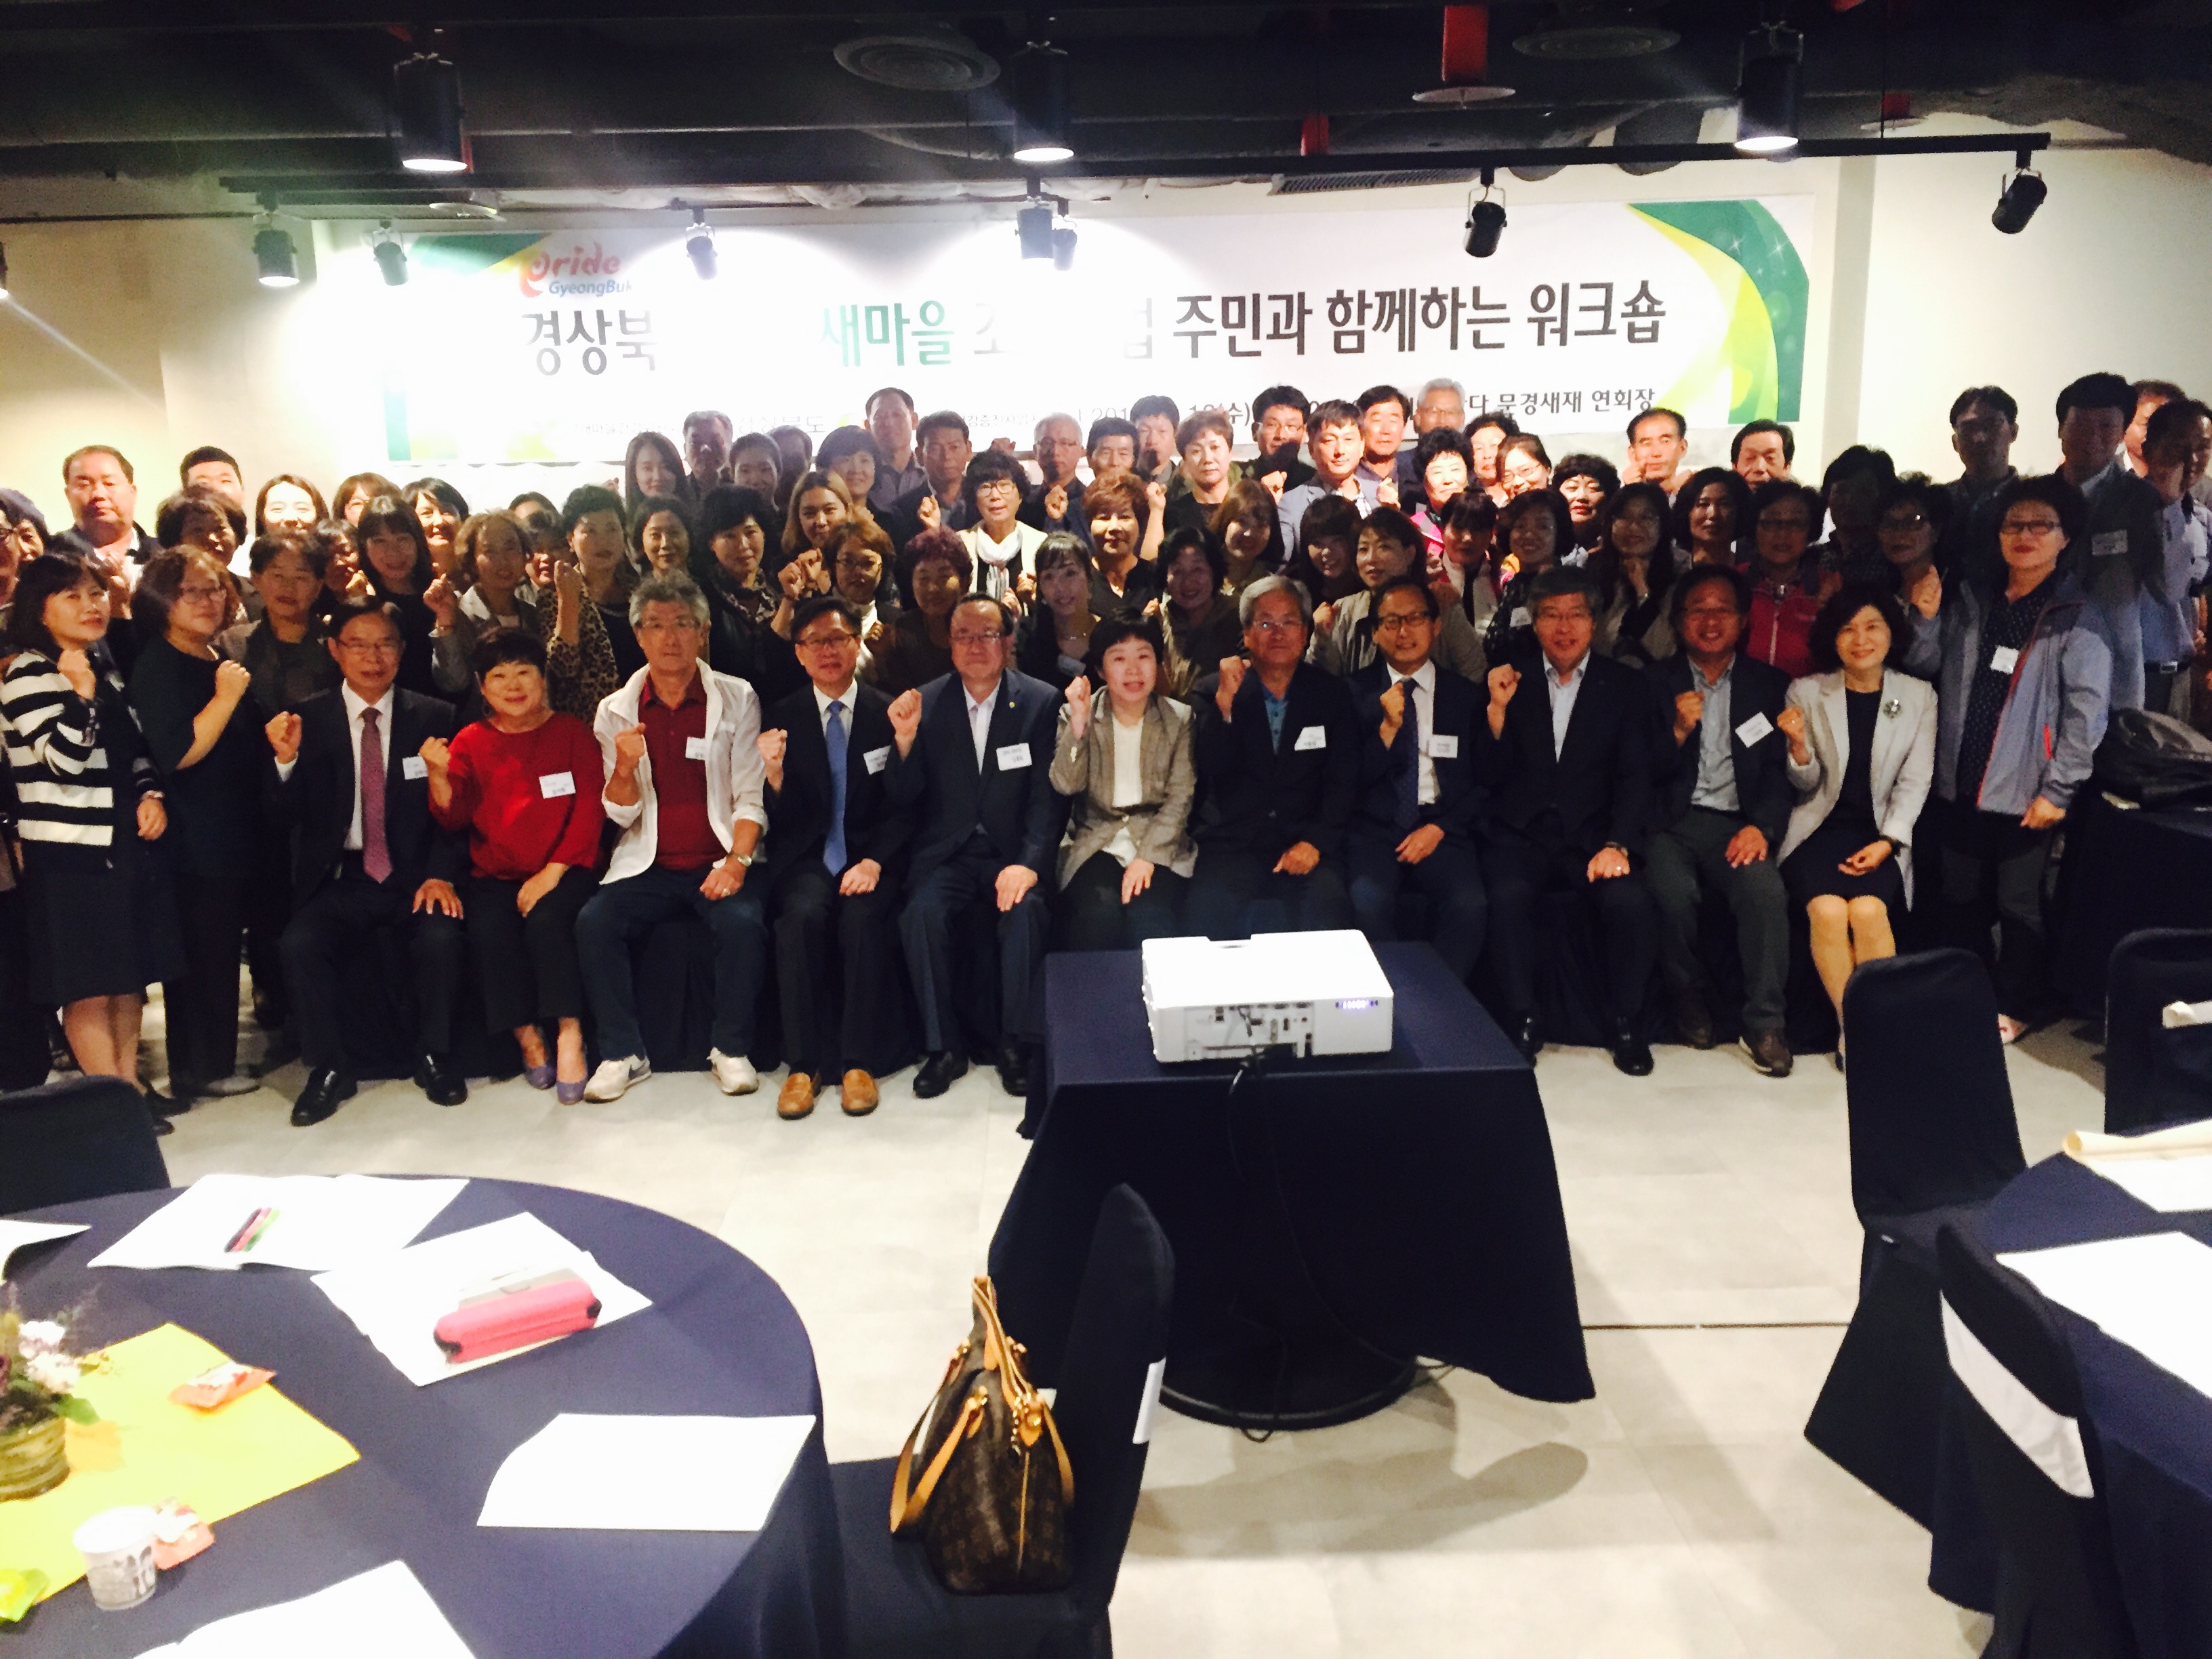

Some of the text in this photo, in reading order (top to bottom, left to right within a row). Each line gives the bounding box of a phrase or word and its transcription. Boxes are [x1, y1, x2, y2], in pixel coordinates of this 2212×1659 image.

[819, 300, 955, 367] 새마을
[1172, 291, 1313, 359] 주민과
[1326, 285, 1511, 354] 함께하는
[1527, 280, 1666, 346] 워크숍
[1496, 390, 1582, 415] 문경새재
[1591, 388, 1656, 413] 연회장
